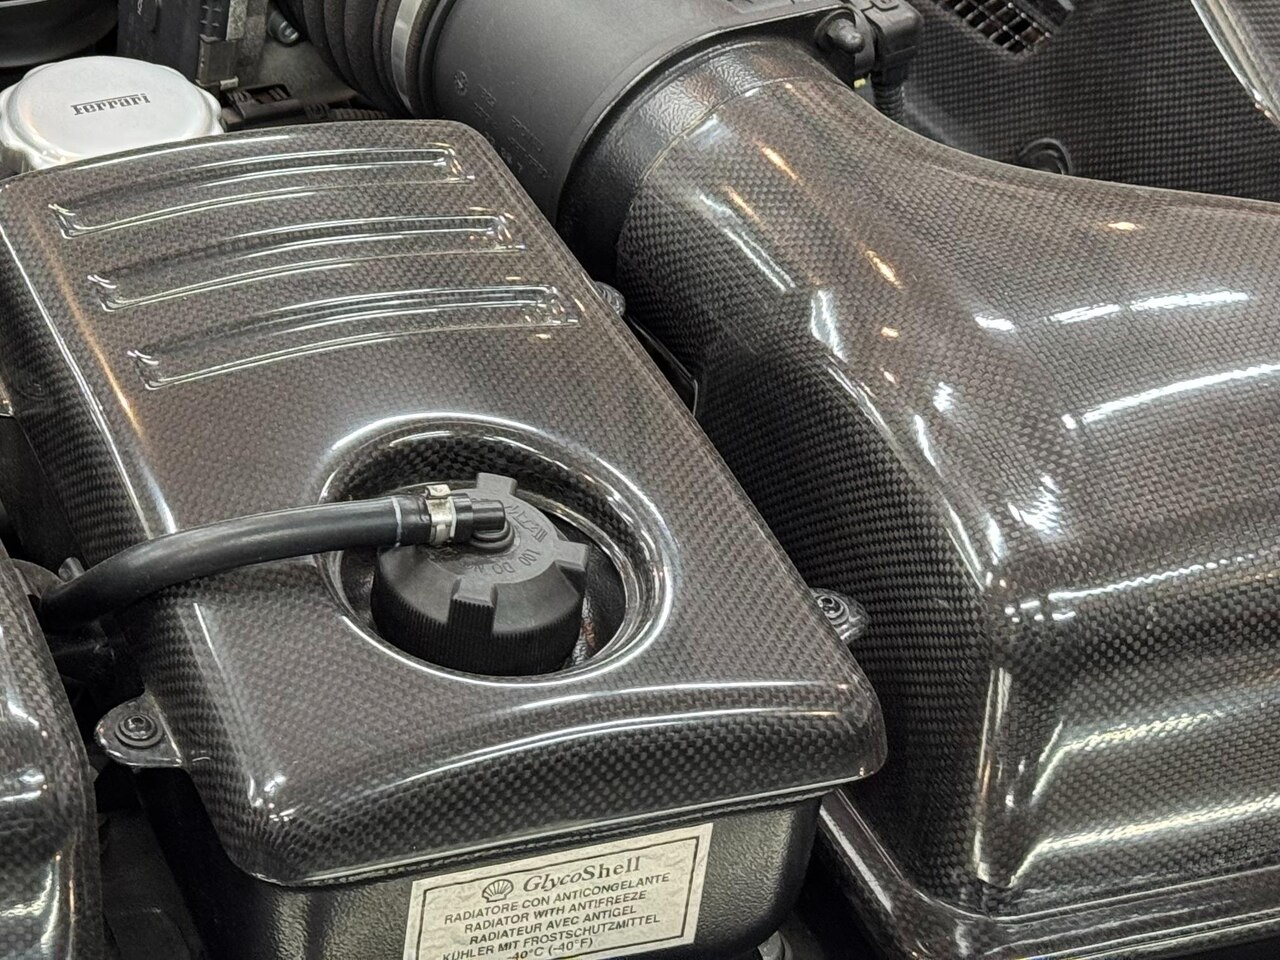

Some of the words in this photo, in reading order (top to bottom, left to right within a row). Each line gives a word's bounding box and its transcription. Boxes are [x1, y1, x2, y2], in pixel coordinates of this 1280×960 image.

[70, 92, 151, 116] Ferrari
[522, 855, 641, 893] GlycoShell
[443, 901, 519, 925] RADIATORE
[521, 895, 551, 909] CON
[553, 872, 671, 904] ANTICONGELANTE
[464, 912, 530, 934] RADIATOR
[533, 905, 566, 920] WITH
[568, 889, 648, 914] ANTIFREEZE
[468, 922, 543, 946] RADIATEUR
[545, 915, 581, 932] AVEC
[582, 904, 638, 923] ANTIGEL
[497, 939, 521, 954] MIT
[523, 913, 662, 948] FROSTSCHUTZMITTEL
